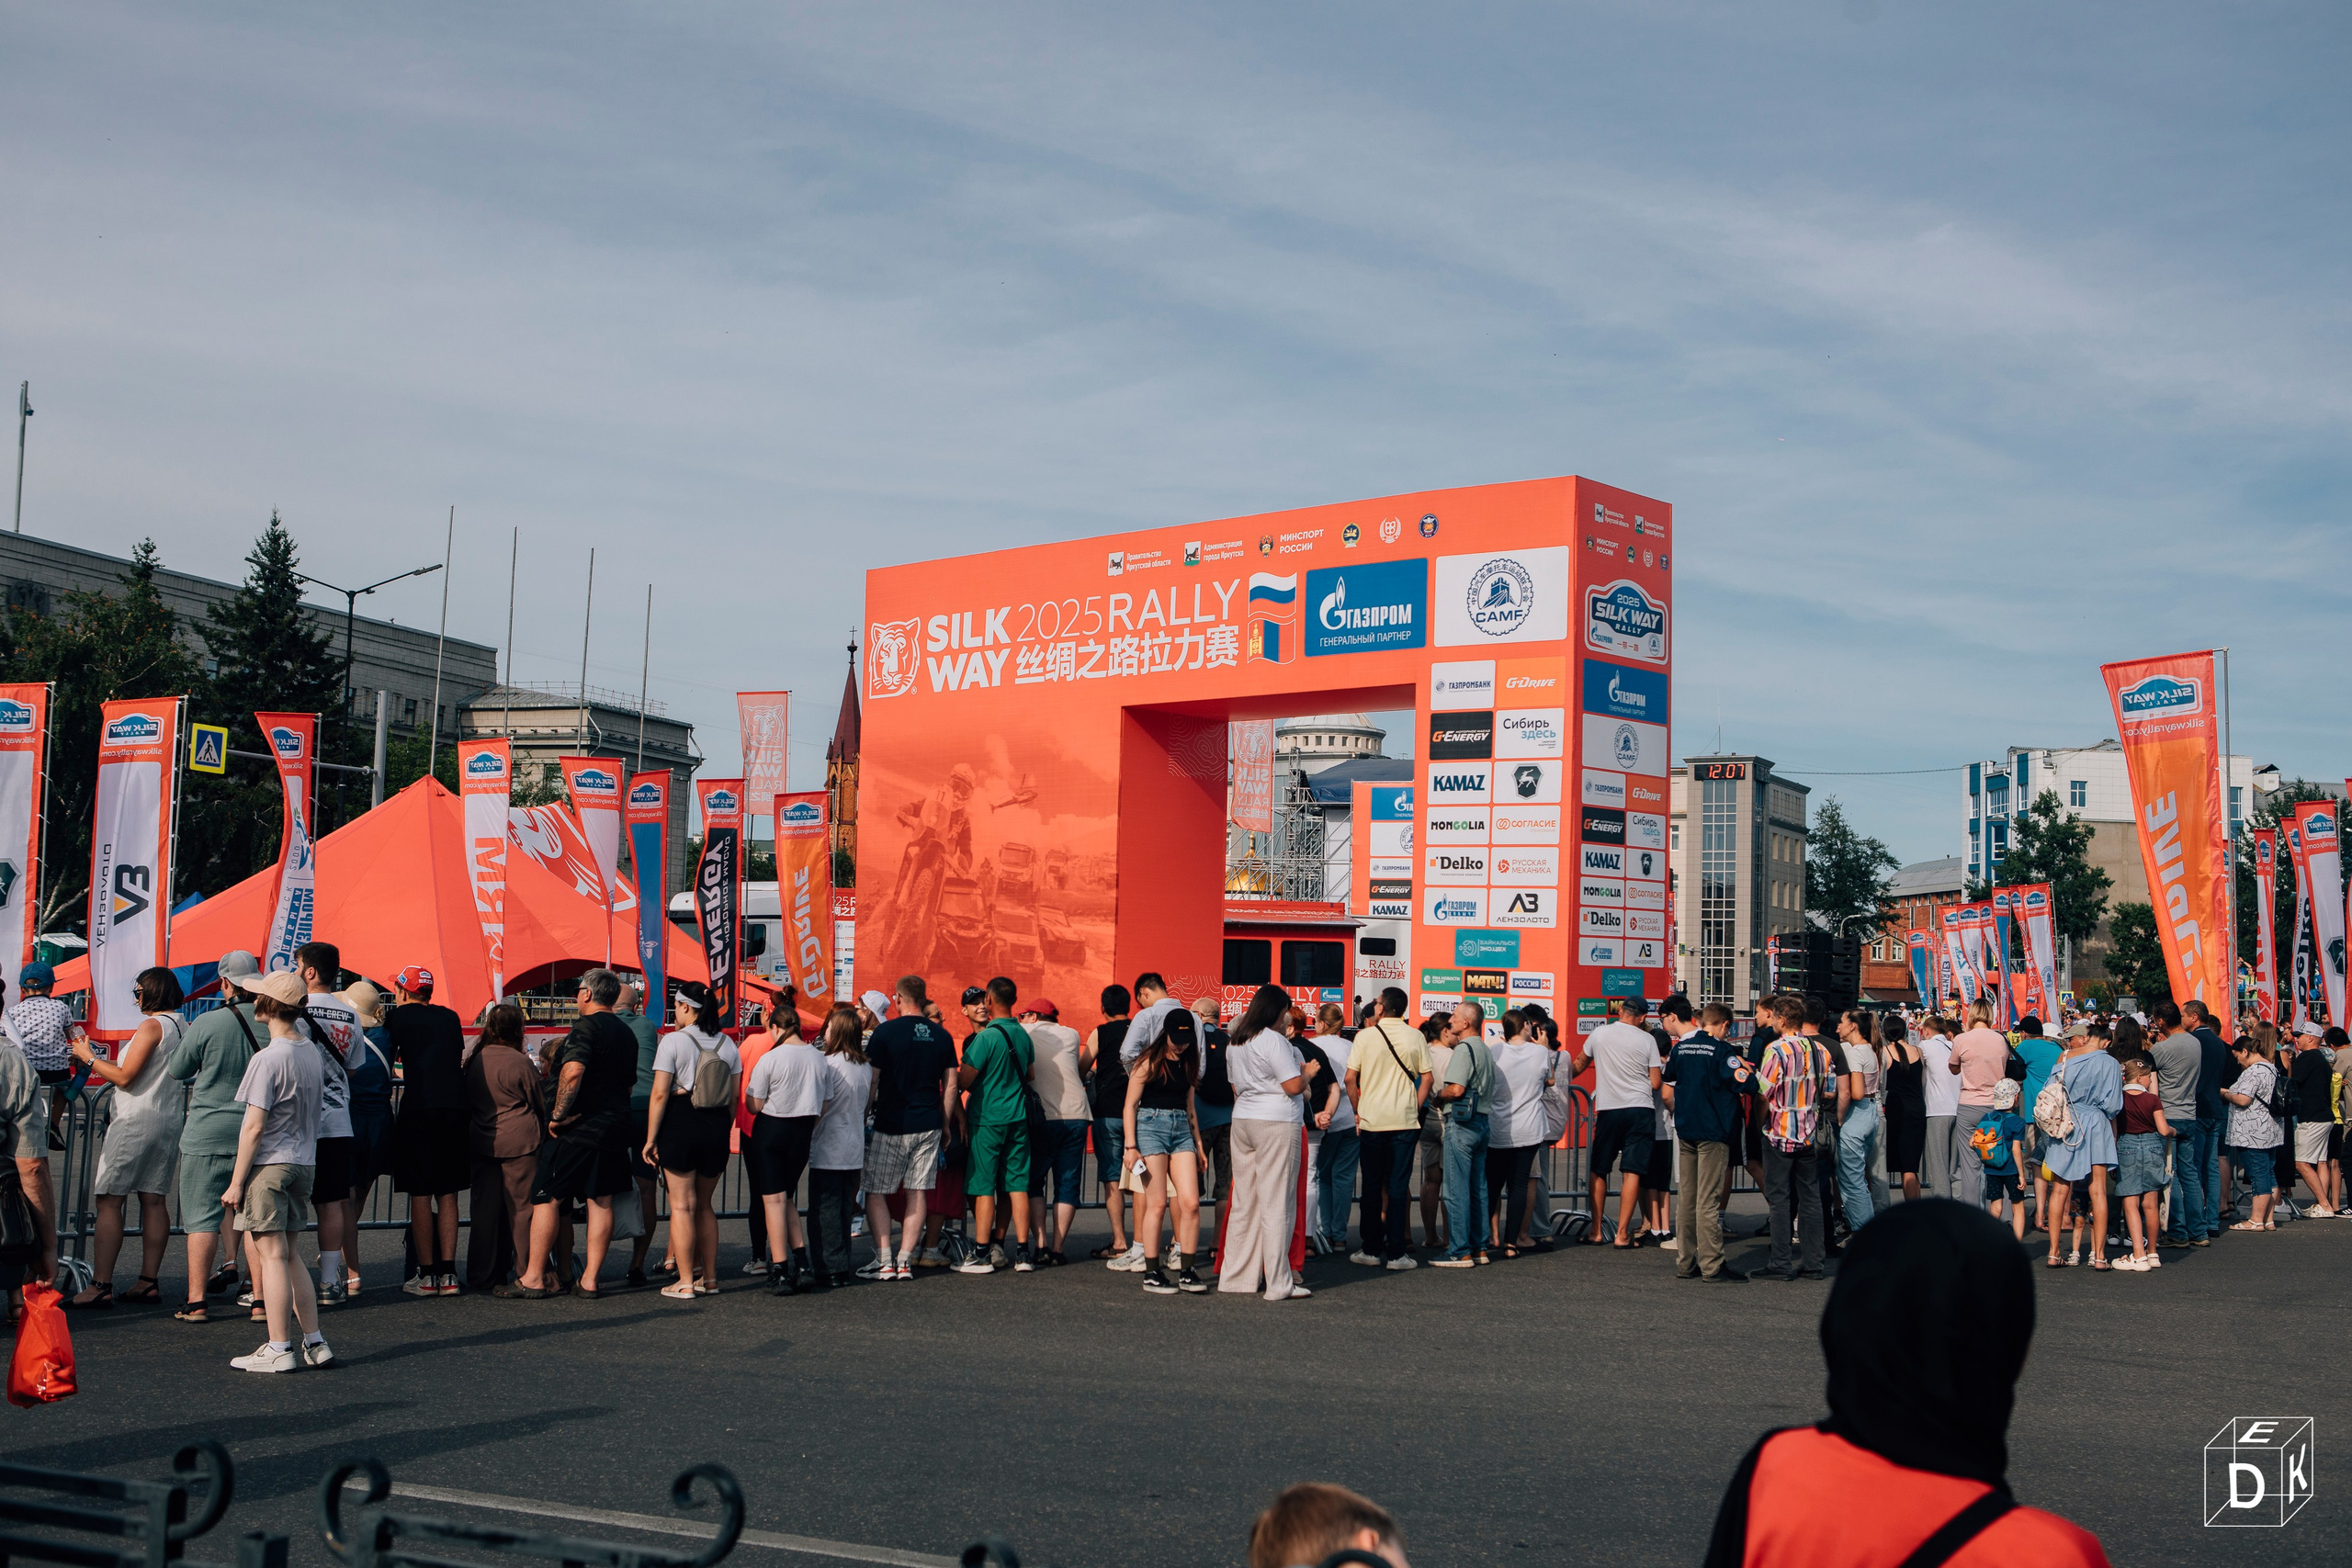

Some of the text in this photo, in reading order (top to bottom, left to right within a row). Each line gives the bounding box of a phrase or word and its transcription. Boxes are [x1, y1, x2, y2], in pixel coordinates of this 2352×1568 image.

[1280, 529, 1324, 542] МИНСПОРТ
[1204, 540, 1243, 551] Администрация
[1279, 542, 1313, 554] РОССИИ
[1126, 550, 1162, 561] Правительство
[1203, 549, 1244, 562] города Иркутска
[1126, 559, 1171, 571] Иркутской области
[1617, 594, 1640, 607] 2025
[926, 578, 1240, 652] SILK 2025 RALLY
[1347, 604, 1412, 629] ГАЗПРОМ
[1476, 609, 1523, 623] CAMF
[1595, 601, 1661, 629] SILK WAY
[1615, 624, 1641, 634] RALLY
[1320, 631, 1412, 647] ГЕНЕРАЛЬНЫЙ ПАРТНЕР
[1014, 624, 1240, 685] 丝绸之路拉力赛
[926, 648, 1007, 693] WAY
[1448, 680, 1491, 689] ГАЗПРОМБАНК
[1620, 691, 1646, 707] ГАЗПРОМ
[1503, 717, 1550, 731] Сибирь
[1521, 729, 1556, 740] здесь
[1617, 753, 1636, 761] CAMF
[1433, 775, 1486, 792] KAMAZ
[1430, 820, 1485, 831] MONGOLIA
[1633, 815, 1657, 829] Сибирь
[1643, 828, 1660, 837] здесь
[1440, 856, 1484, 870] Delko
[1586, 851, 1621, 870] KAMAZ
[1583, 886, 1621, 898] MONGOLIA
[1638, 890, 1663, 899] СОГЛАСИЕ
[1373, 905, 1408, 915] KAMAZ
[1447, 901, 1476, 911] ГАЗПРОМ
[1591, 911, 1621, 926] Delko
[1369, 959, 1406, 969] RALLY
[1467, 975, 1505, 990] МАТЧ!
[1422, 1000, 1450, 1011] ИЗВЕСТИЯ
[326, 1010, 349, 1021] CREW
